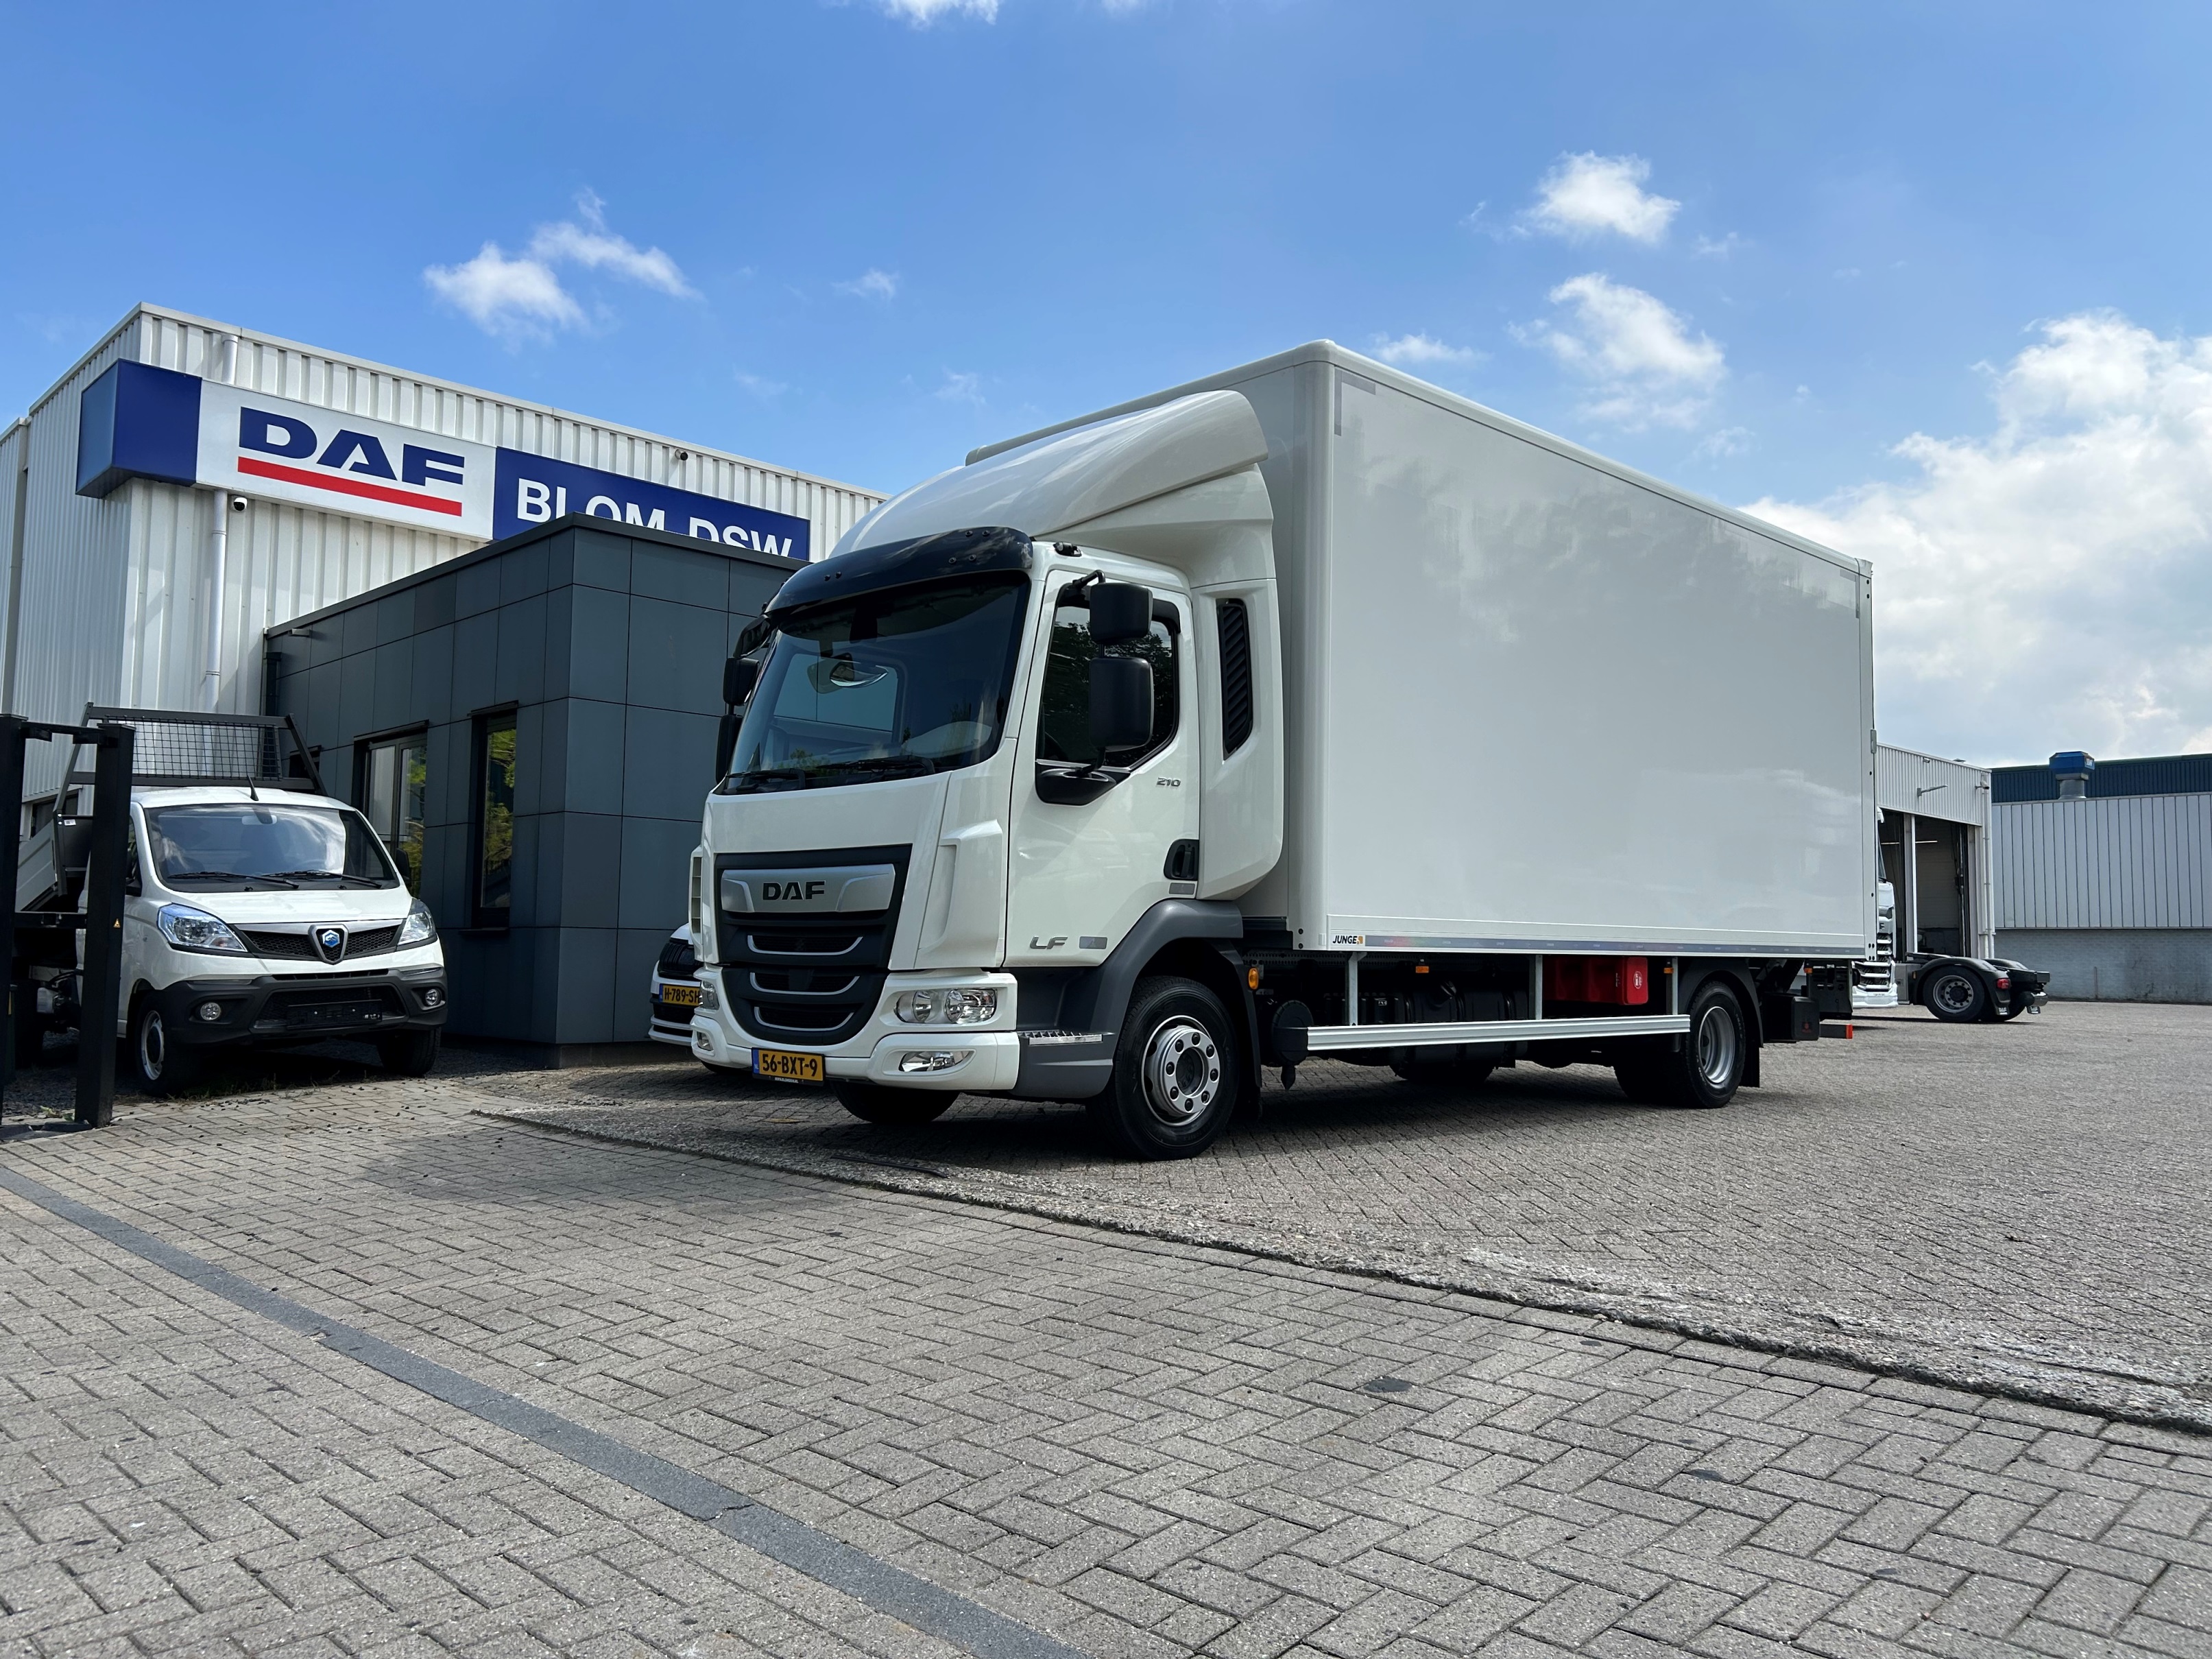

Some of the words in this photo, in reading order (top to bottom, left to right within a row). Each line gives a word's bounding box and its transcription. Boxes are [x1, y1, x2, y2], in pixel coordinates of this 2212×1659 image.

[239, 406, 465, 487] DAF
[1157, 777, 1181, 787] 210
[762, 881, 826, 900] DAF
[1029, 935, 1068, 950] LF
[1332, 935, 1358, 944] JUNGE
[762, 1053, 818, 1077] 56-BXT-9
